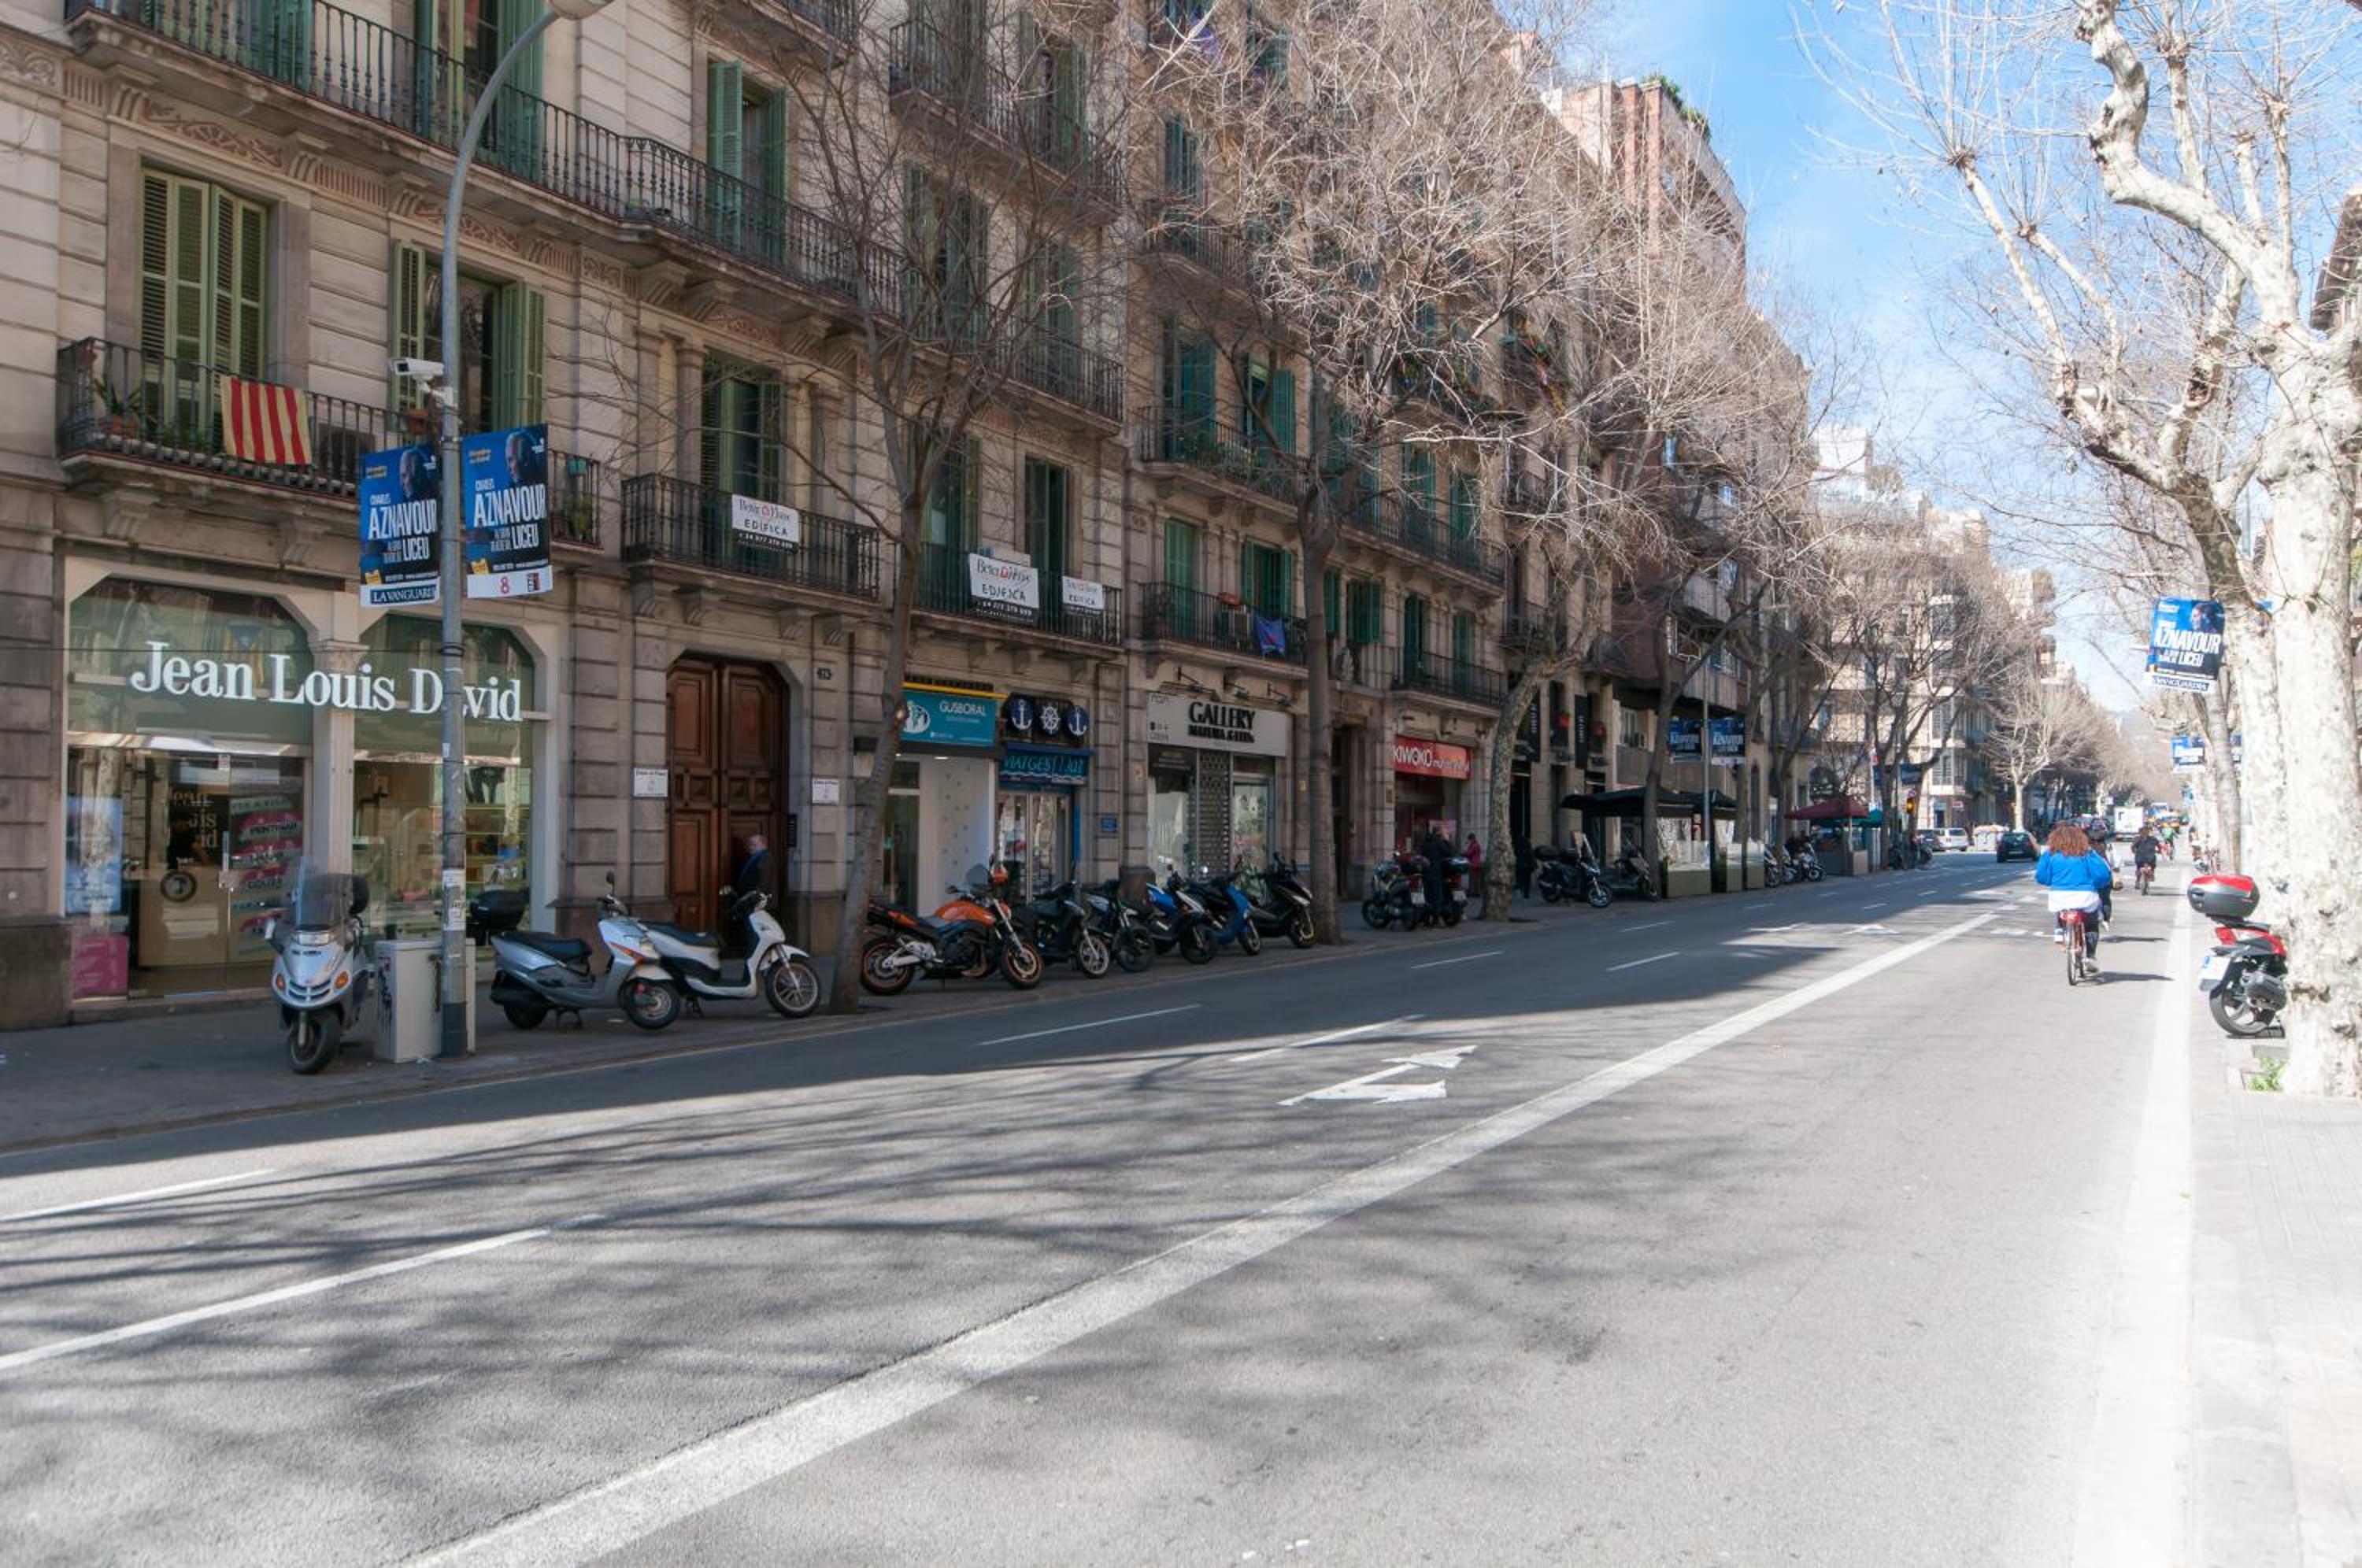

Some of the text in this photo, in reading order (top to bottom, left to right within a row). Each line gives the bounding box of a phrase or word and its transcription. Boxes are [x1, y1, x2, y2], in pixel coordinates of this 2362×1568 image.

[474, 484, 546, 527] AZNAVOUR
[512, 523, 539, 549] LICEU
[744, 520, 787, 535] EDIFICA
[402, 537, 430, 562] LICEU
[982, 583, 1026, 601] EDIFICA
[2154, 630, 2221, 654] AZNAVOUR
[131, 641, 523, 722] Jean Louis Dvid
[1189, 701, 1255, 730] GALLERY
